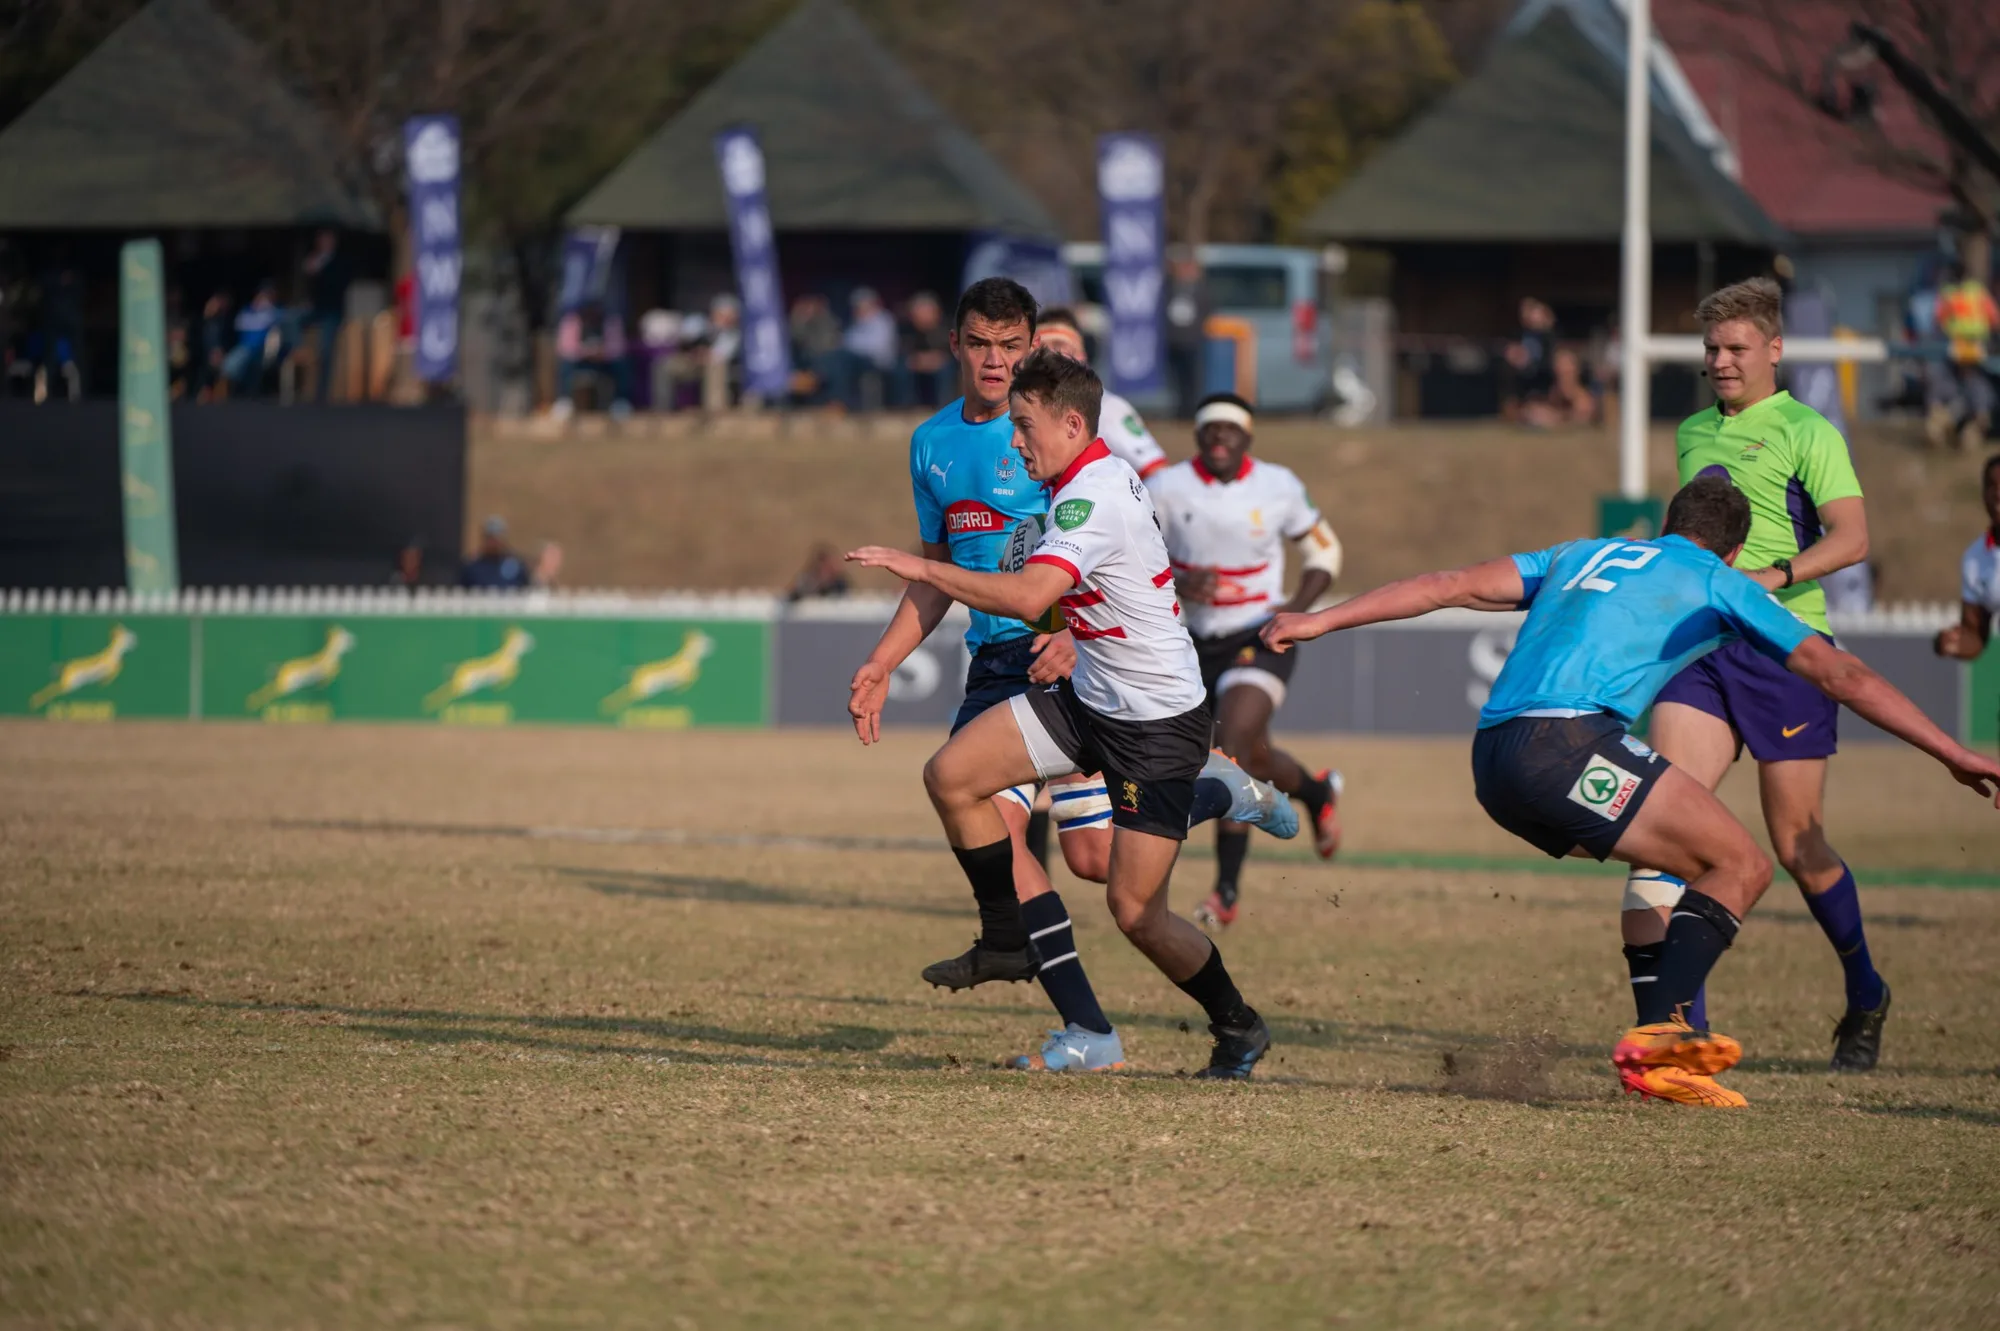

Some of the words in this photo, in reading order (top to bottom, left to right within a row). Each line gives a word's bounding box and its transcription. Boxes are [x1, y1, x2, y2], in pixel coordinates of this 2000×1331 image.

[1057, 509, 1087, 518] CRAVEN
[1561, 542, 1663, 593] 12
[1607, 778, 1638, 817] SPAR
